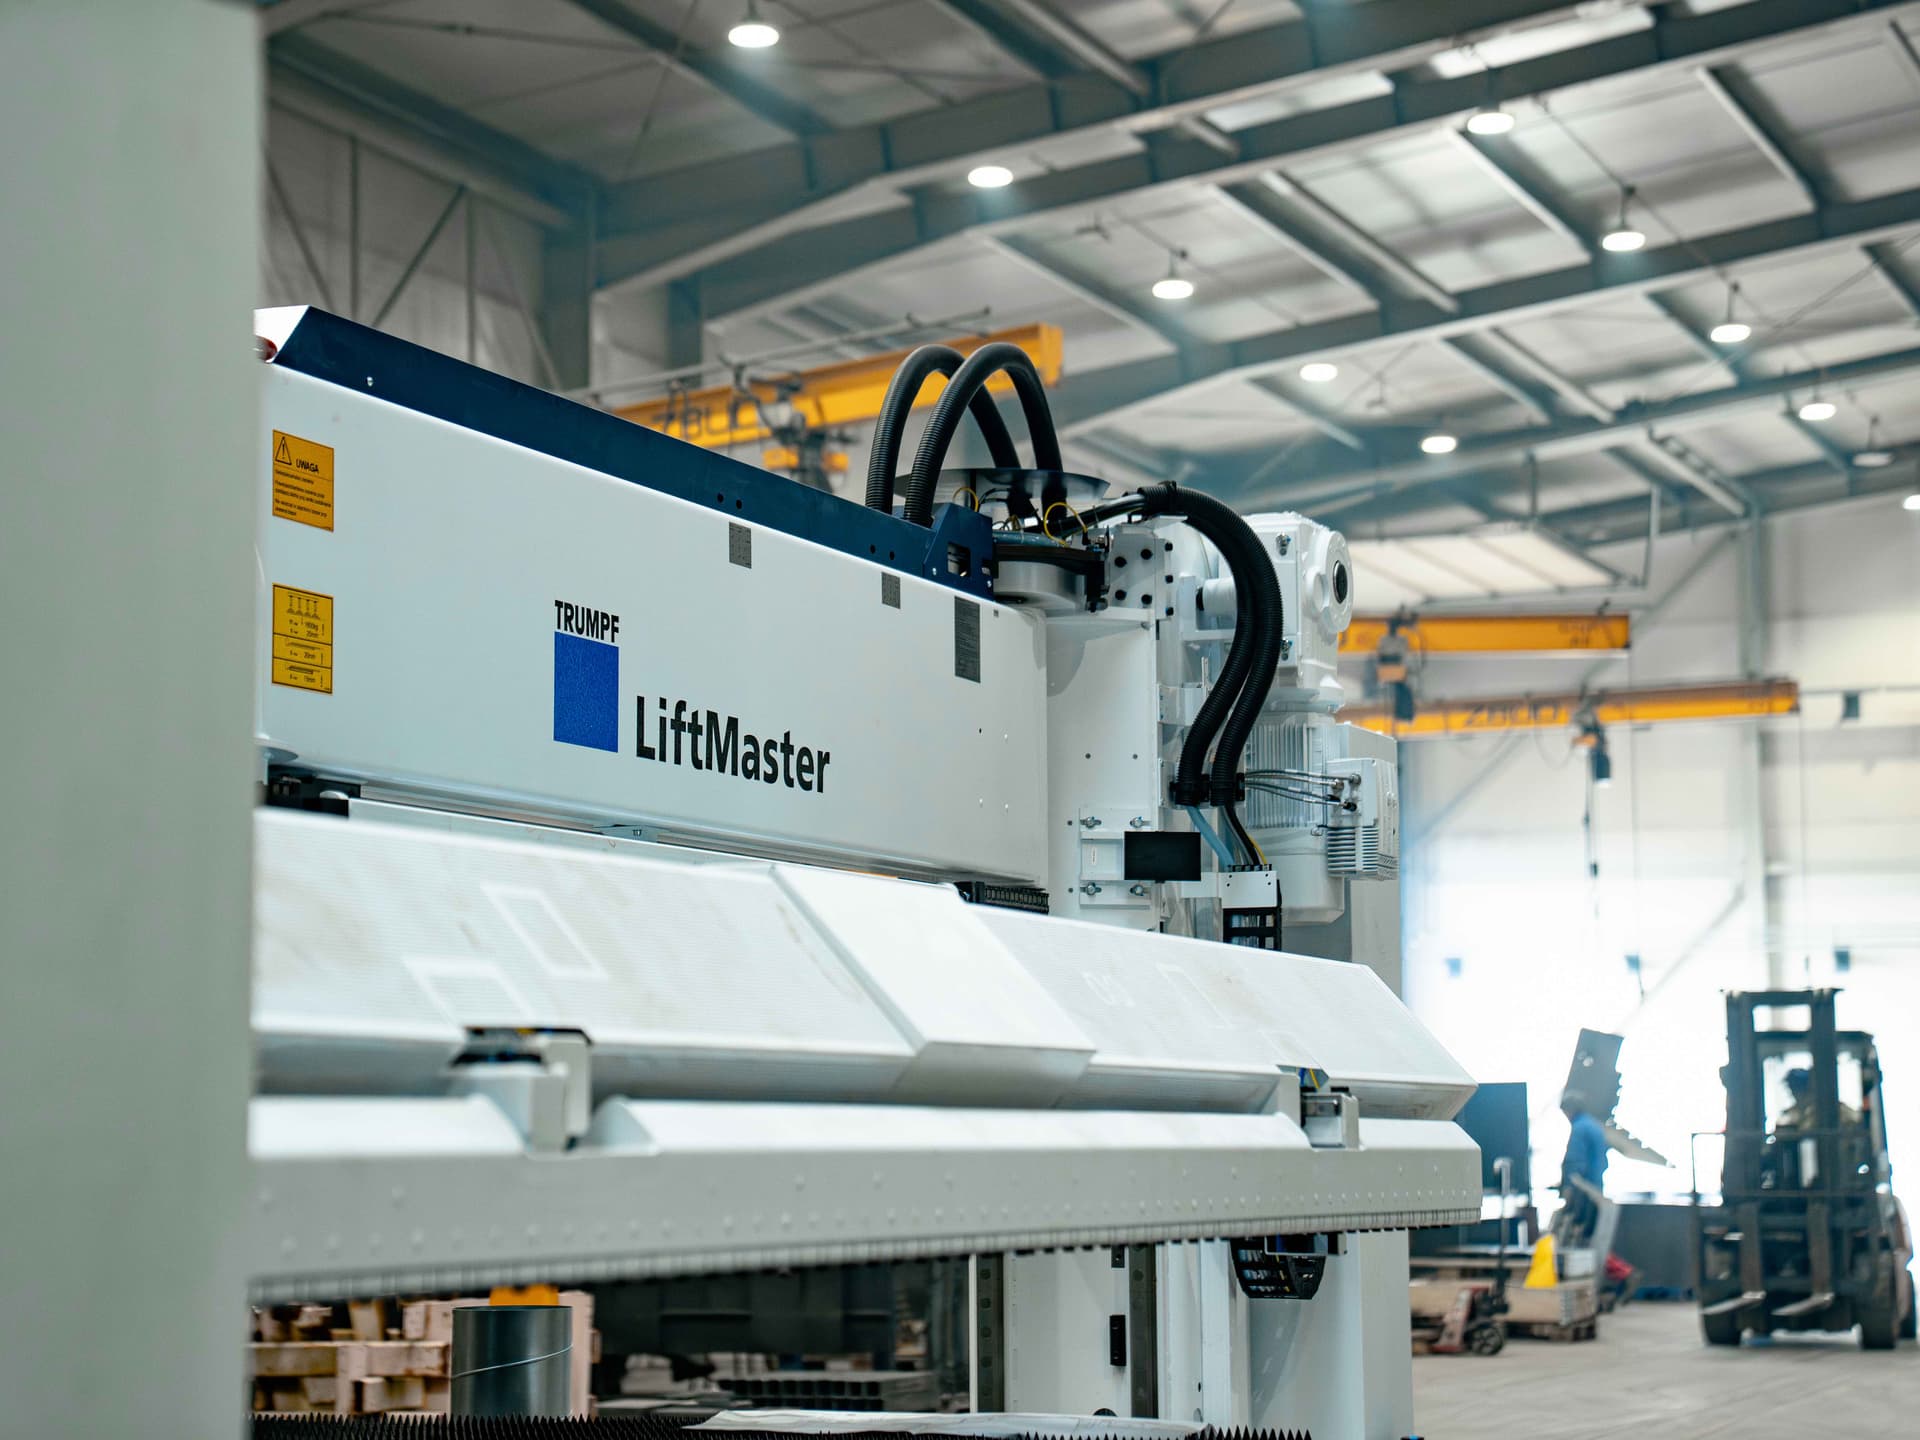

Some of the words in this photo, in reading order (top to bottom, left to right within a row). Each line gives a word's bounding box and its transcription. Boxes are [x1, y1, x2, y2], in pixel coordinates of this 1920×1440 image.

[296, 458, 319, 473] UWAGA
[554, 600, 620, 643] TRUMPF
[636, 695, 830, 794] LiftMaster
